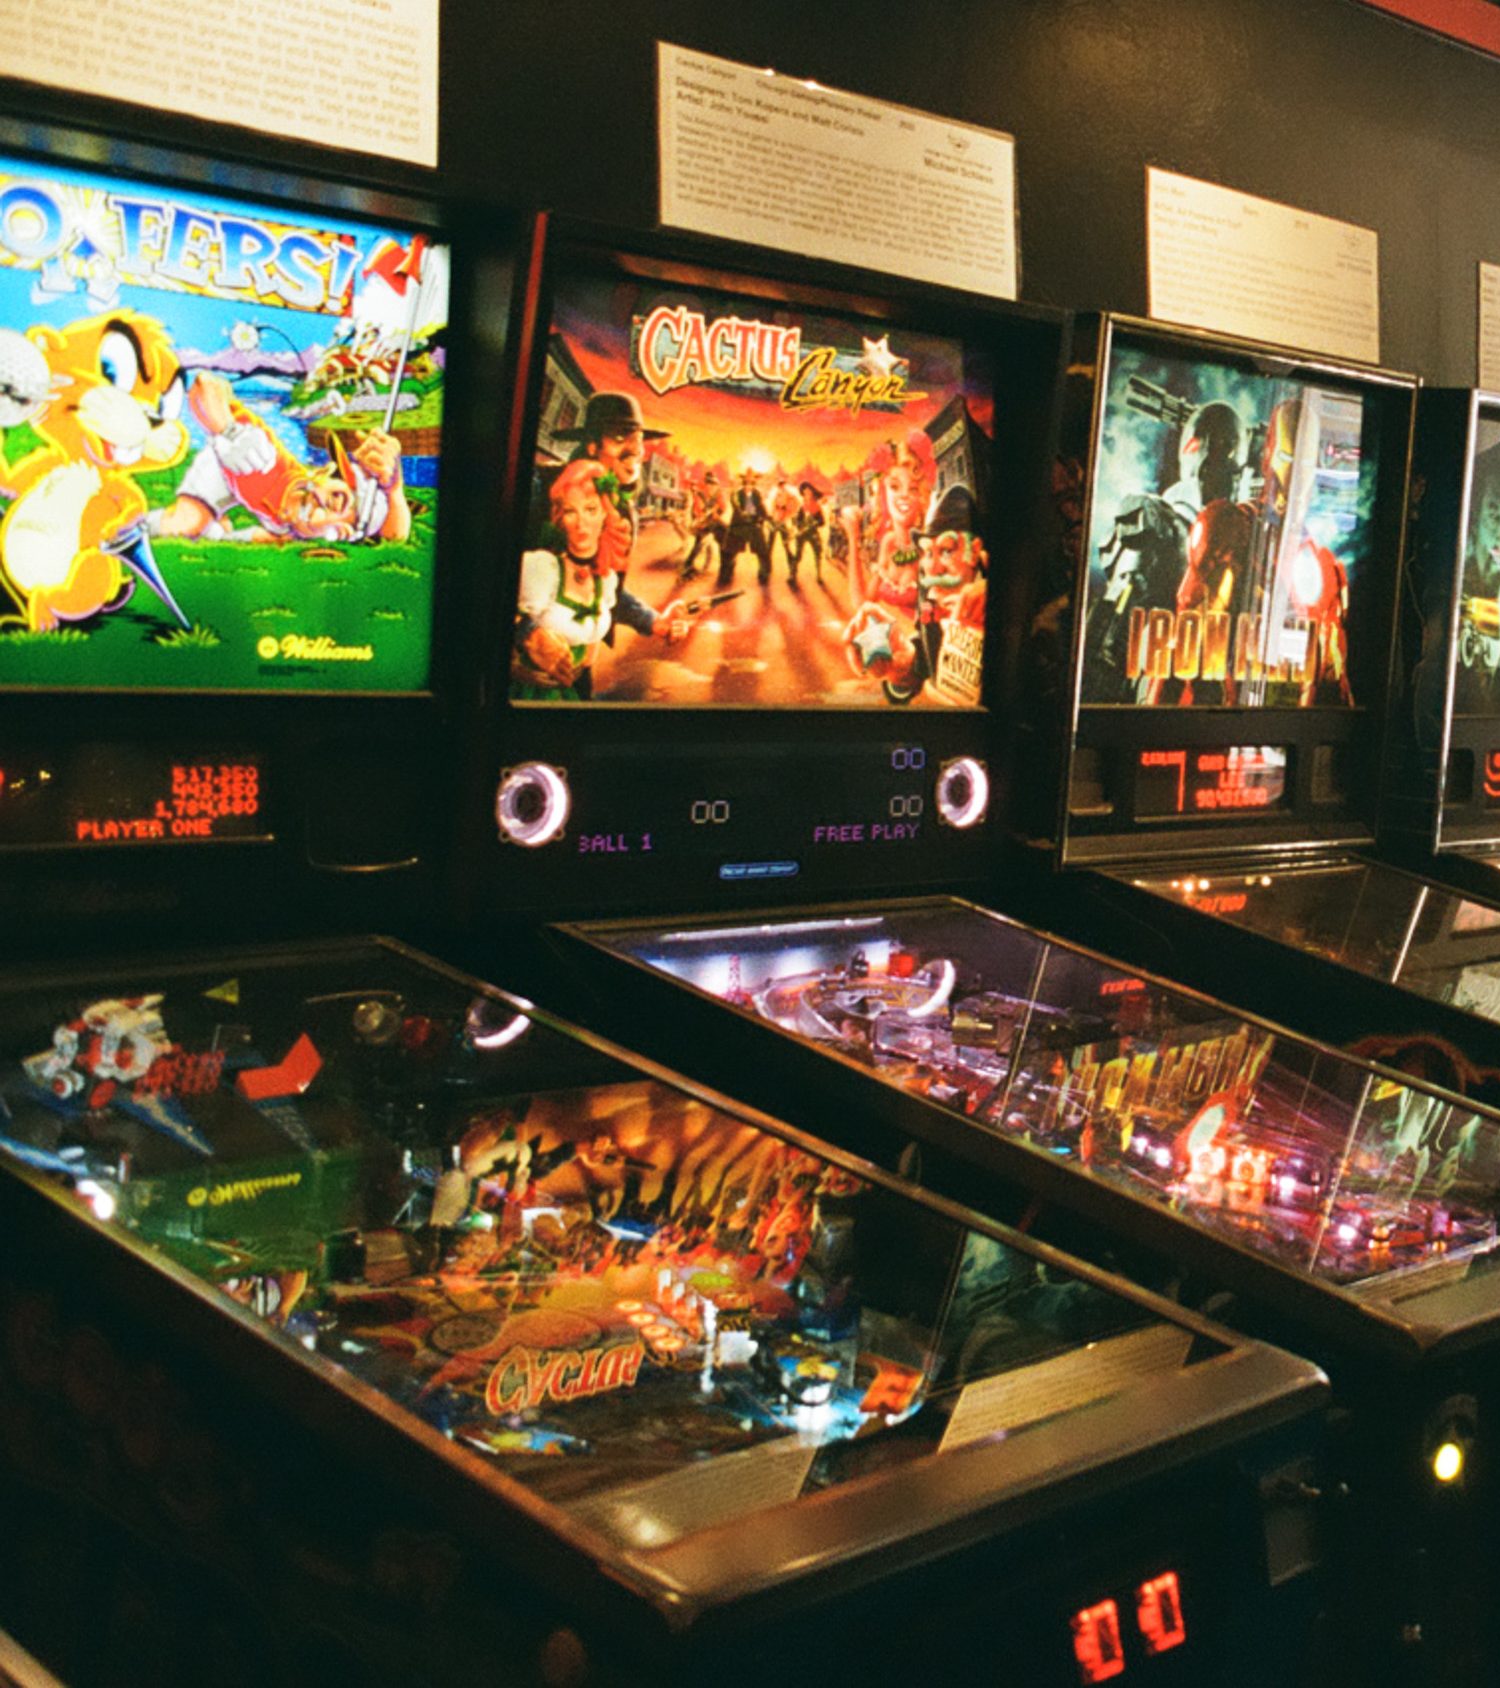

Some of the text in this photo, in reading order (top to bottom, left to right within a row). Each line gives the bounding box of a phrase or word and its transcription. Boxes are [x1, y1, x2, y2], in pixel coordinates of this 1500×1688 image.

[638, 305, 801, 396] CACTUS
[779, 346, 928, 418] Canyon
[280, 633, 373, 661] Williams
[1126, 606, 1231, 681] IRON
[691, 800, 730, 824] 00
[889, 795, 924, 817] 00
[76, 817, 212, 840] PLAYER ONE
[813, 822, 920, 843] FREE PLAY
[641, 833, 653, 851] 1
